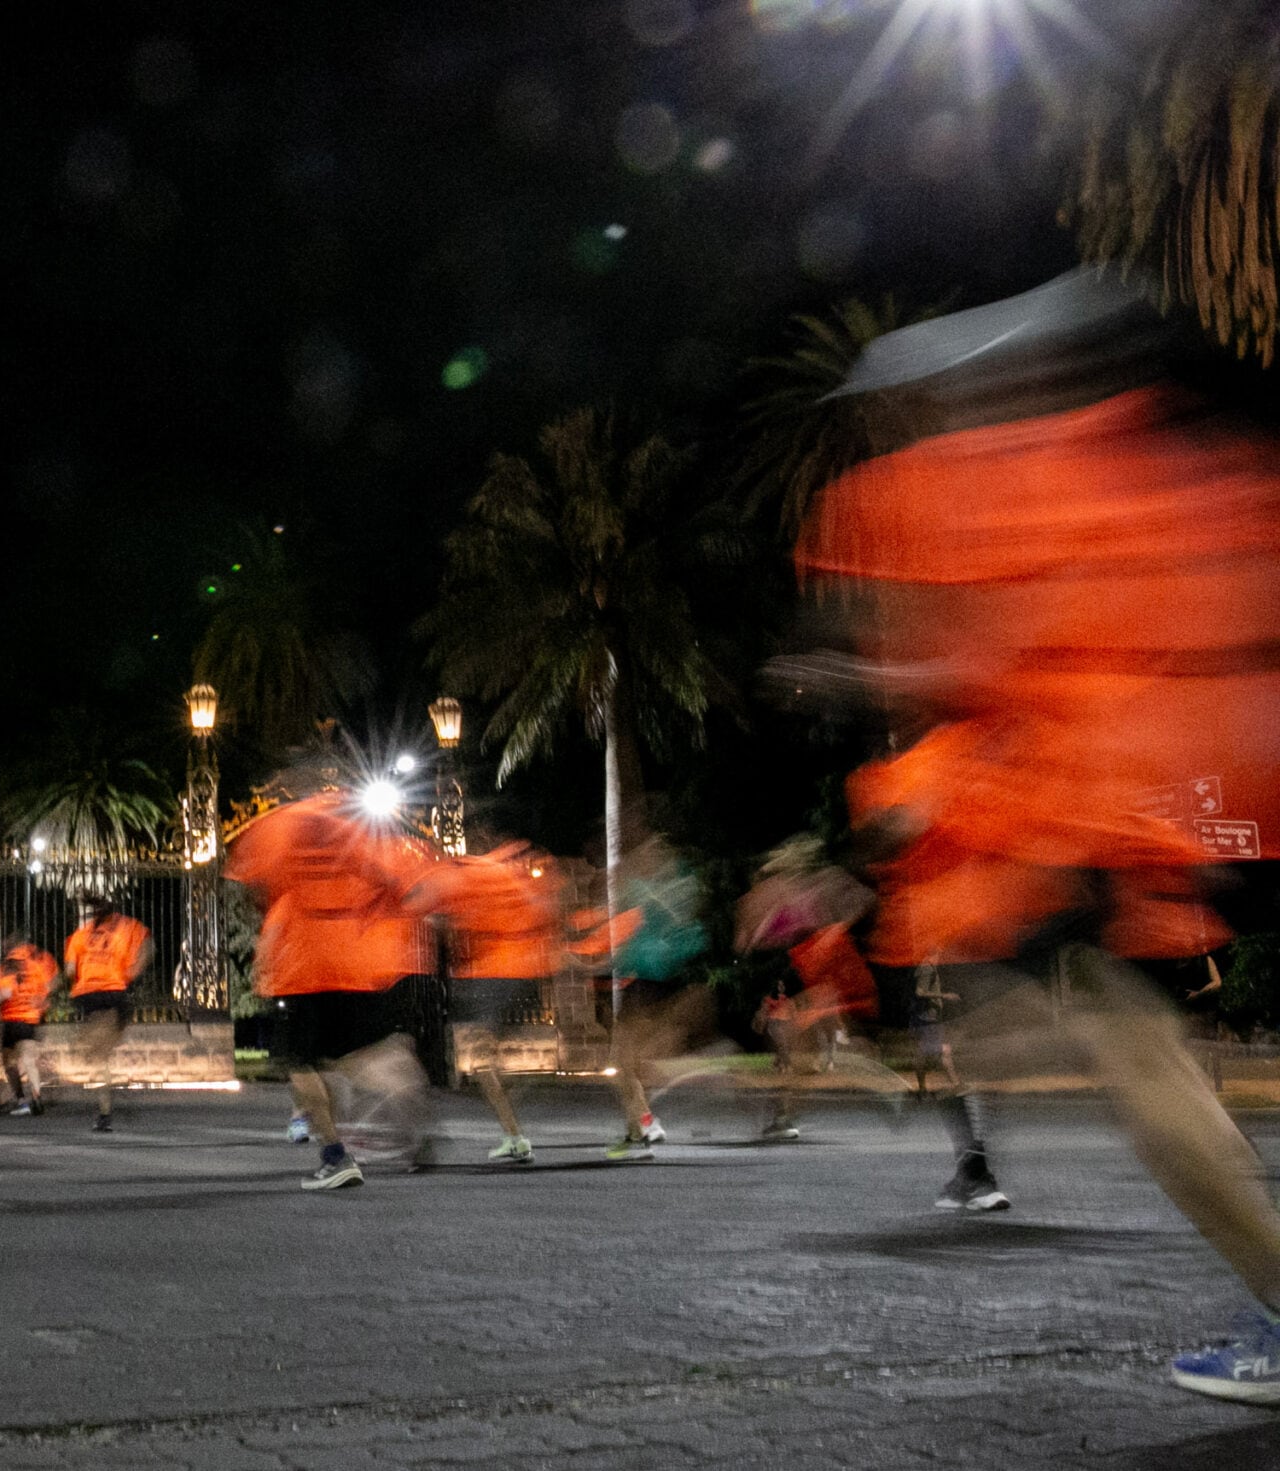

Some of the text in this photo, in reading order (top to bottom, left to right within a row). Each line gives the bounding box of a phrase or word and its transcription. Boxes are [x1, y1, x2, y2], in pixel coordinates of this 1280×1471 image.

[1214, 826, 1252, 836] Boulogne
[1201, 836, 1232, 845] Sur Mer
